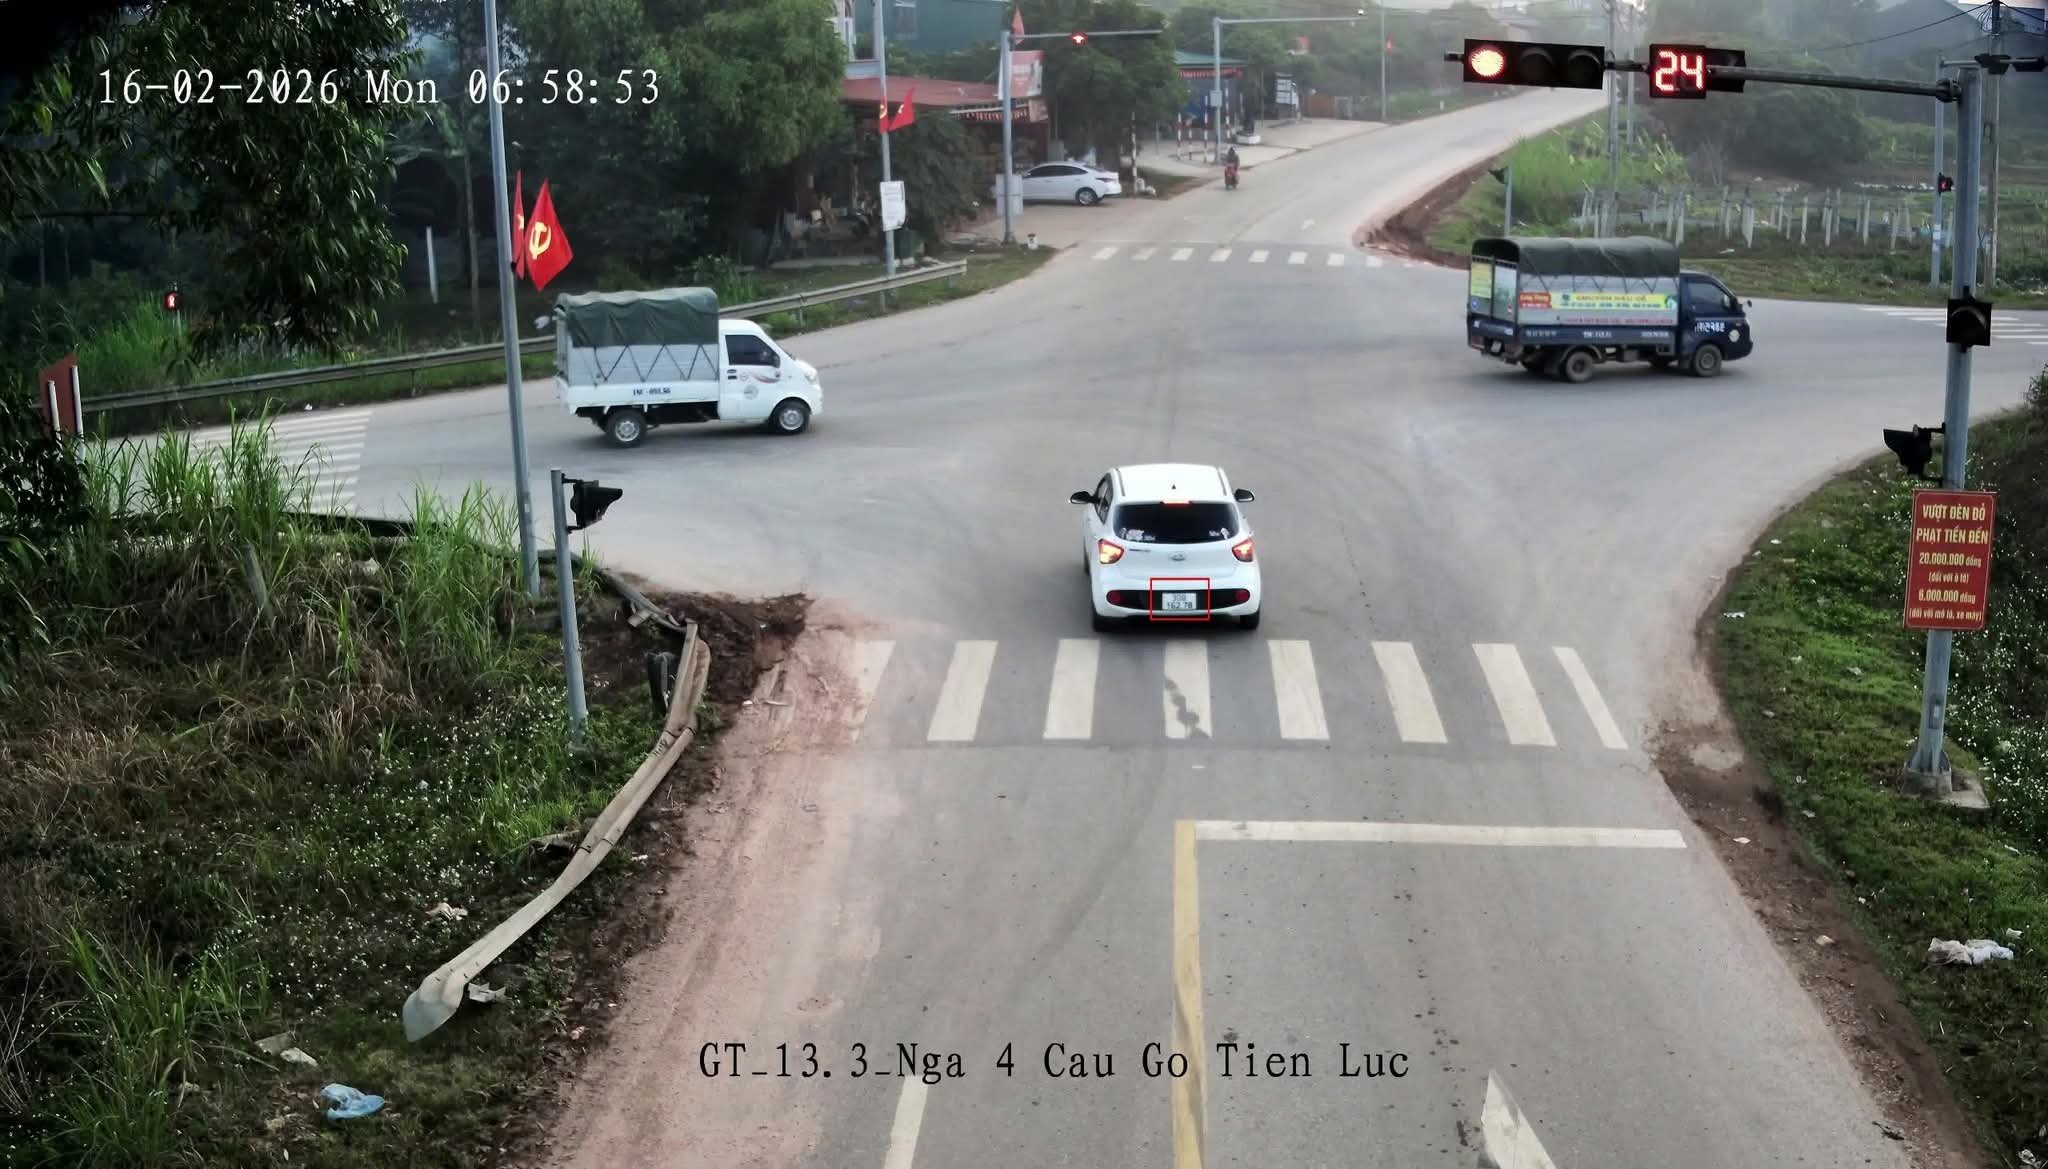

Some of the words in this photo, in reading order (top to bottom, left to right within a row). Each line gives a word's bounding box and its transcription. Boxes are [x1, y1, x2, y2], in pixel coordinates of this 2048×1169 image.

[1655, 51, 1703, 91] 24
[1922, 504, 1947, 522] VƯỢT
[1950, 504, 1969, 520] ĐÈN
[1972, 503, 1985, 521] ĐỎ
[1917, 528, 1942, 544] PHẠT
[1969, 526, 1988, 544] ĐẾN
[1919, 552, 1964, 565] 20.000.000
[1919, 589, 1958, 602] 6.000.000
